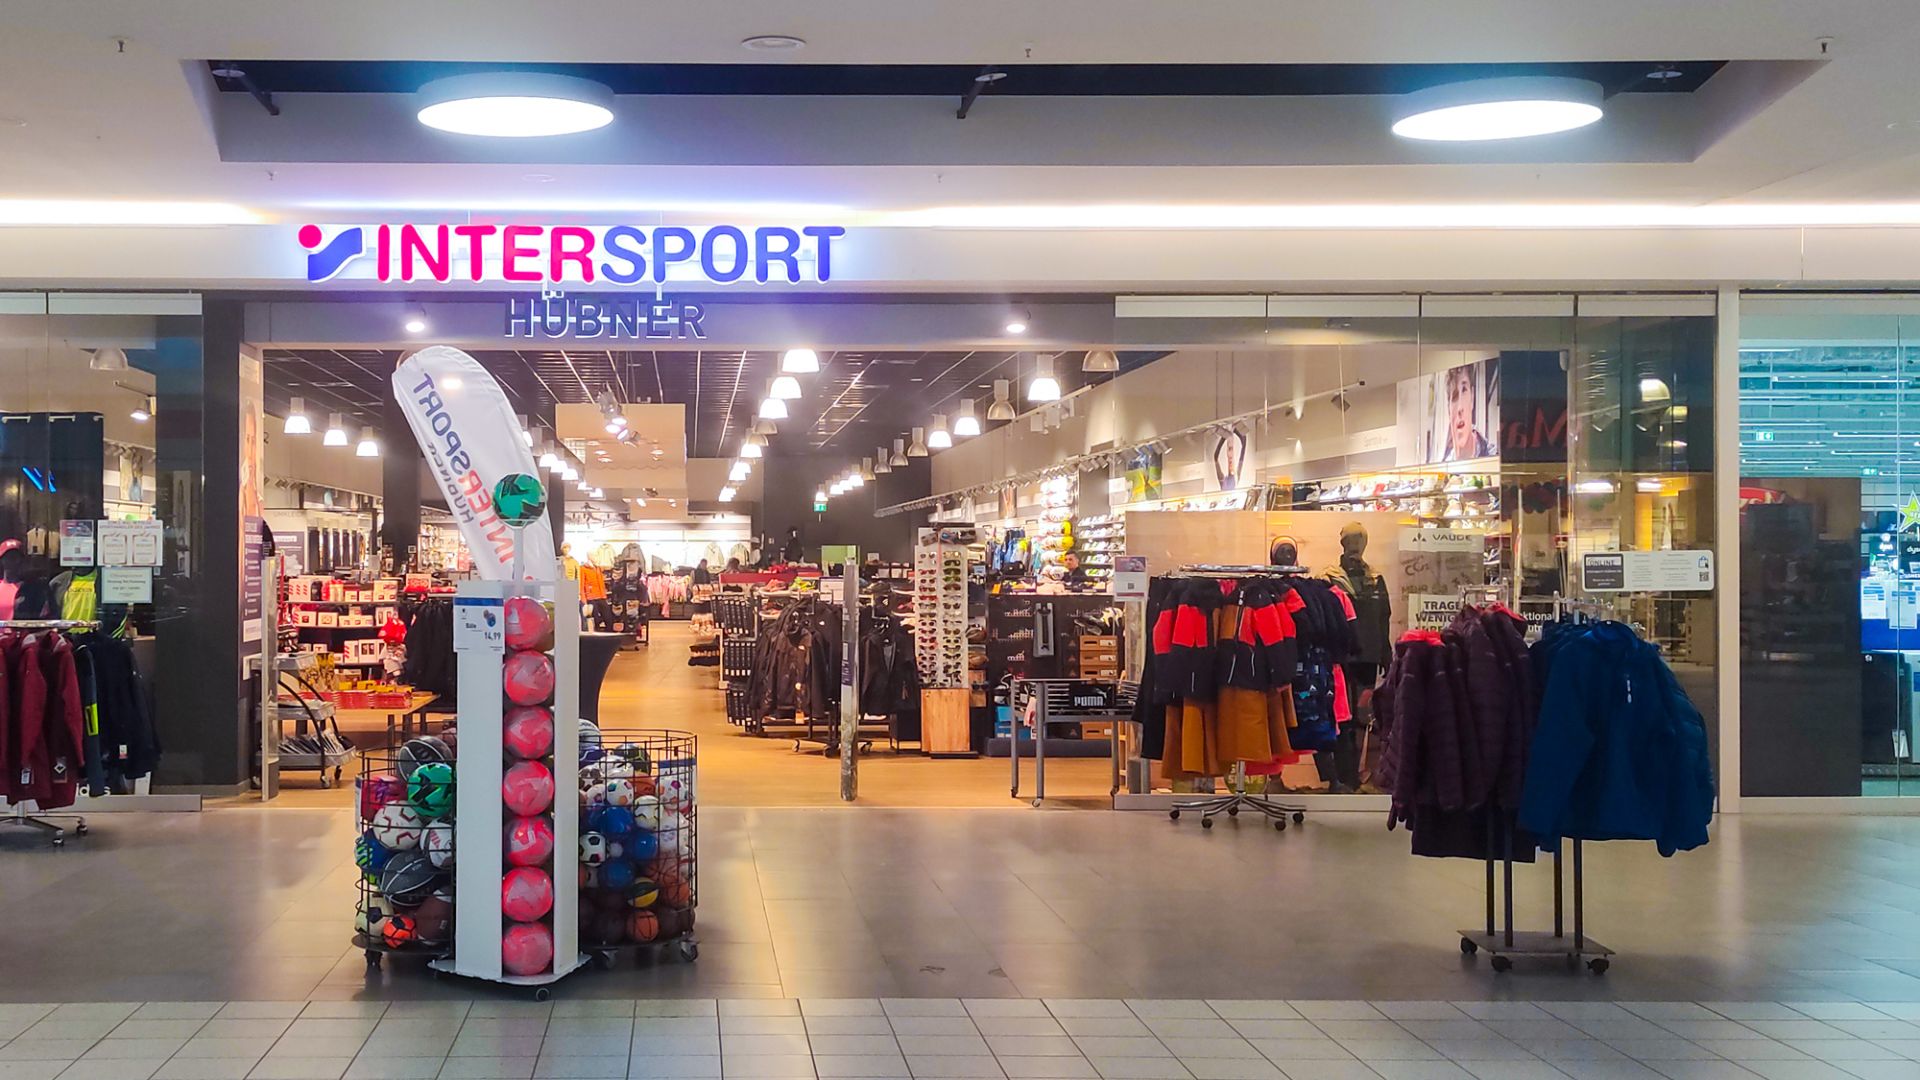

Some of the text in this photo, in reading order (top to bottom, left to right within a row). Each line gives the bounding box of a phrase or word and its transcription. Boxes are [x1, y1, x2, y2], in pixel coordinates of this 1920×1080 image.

[378, 224, 846, 284] INTERSPORT
[504, 289, 708, 340] HÜBNER
[1074, 696, 1104, 707] PUMA
